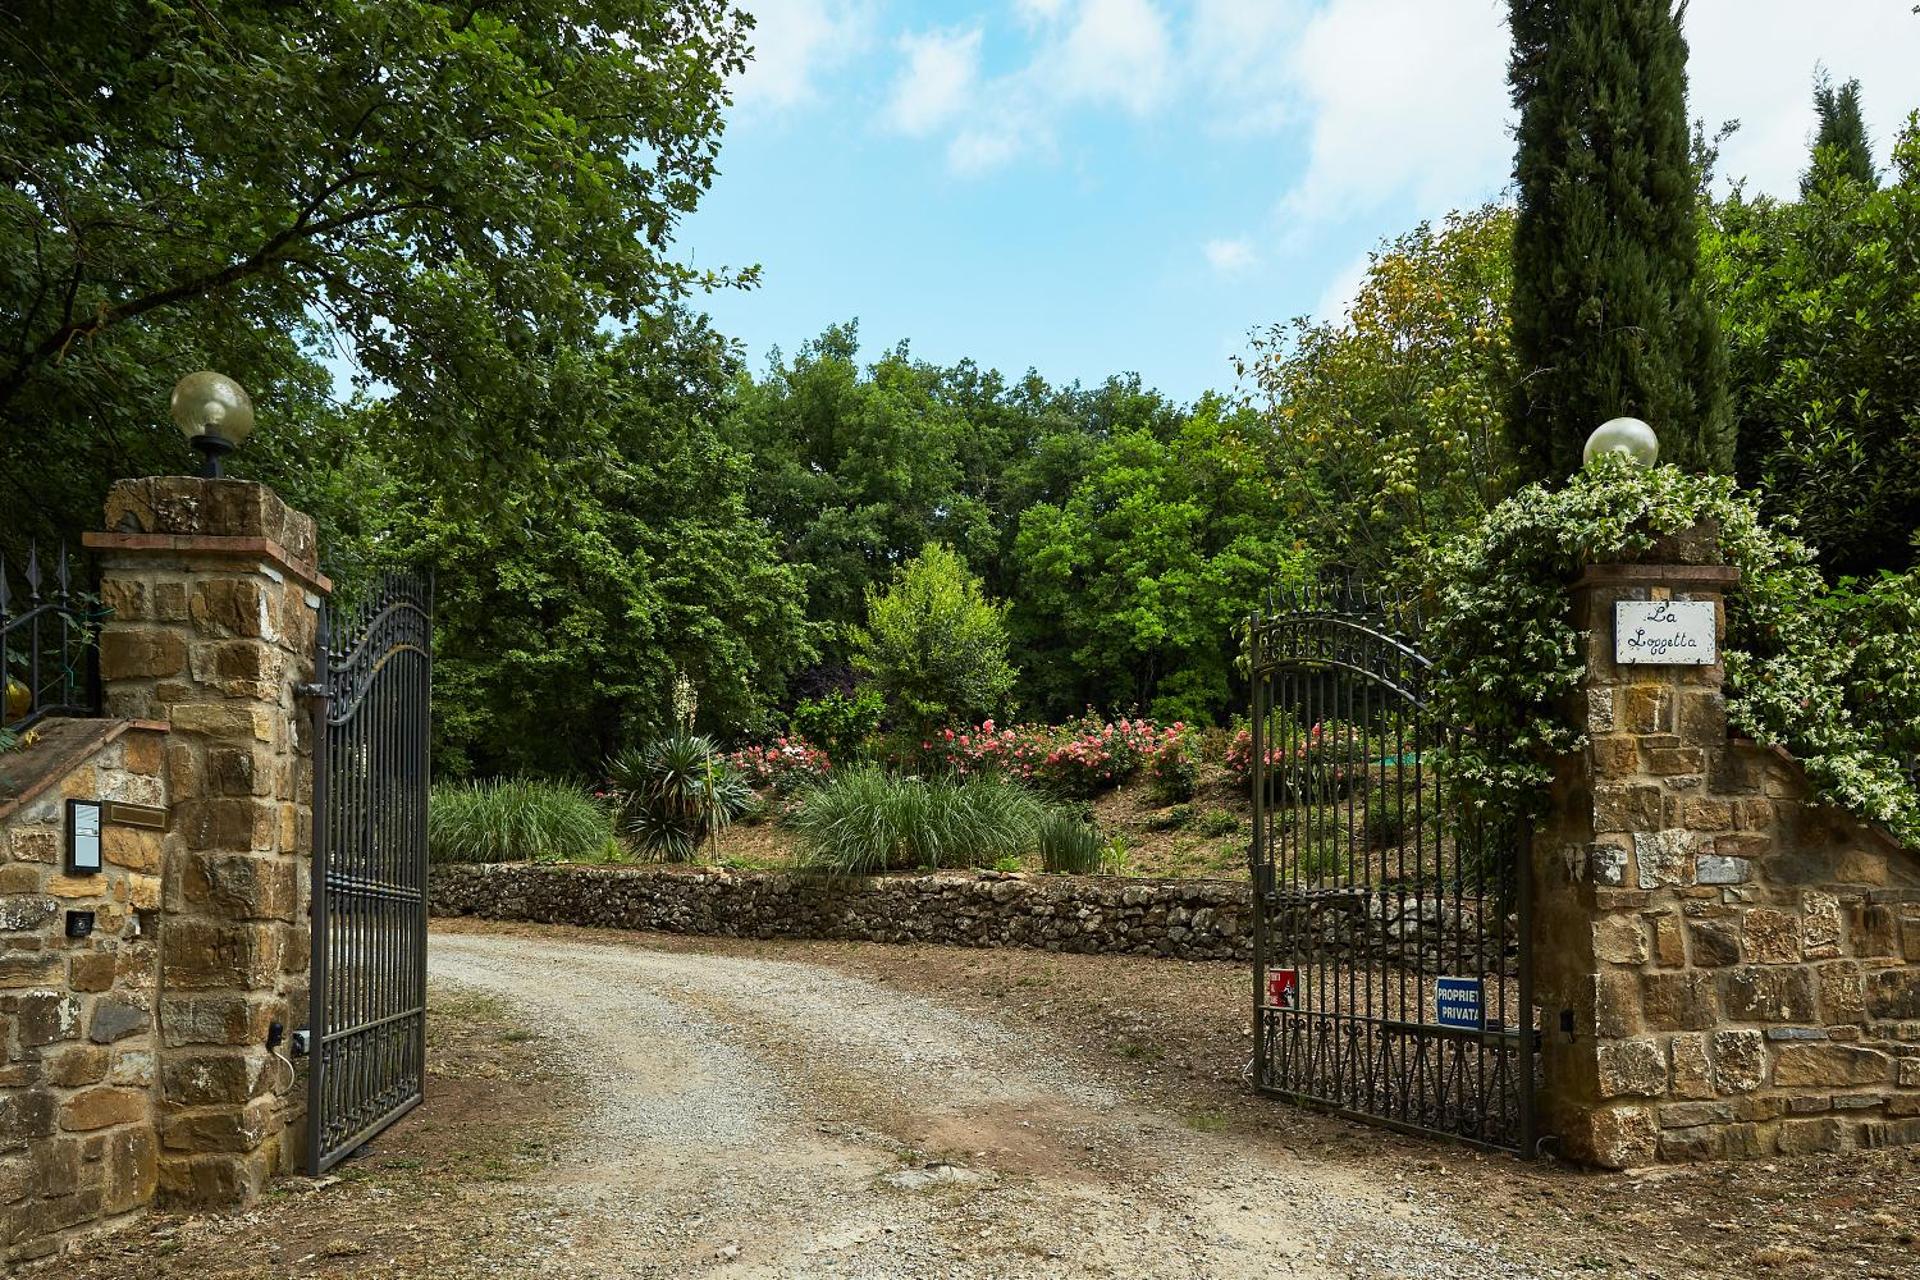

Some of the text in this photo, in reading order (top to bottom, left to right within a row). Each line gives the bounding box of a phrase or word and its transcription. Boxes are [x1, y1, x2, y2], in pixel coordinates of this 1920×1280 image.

[1647, 606, 1677, 622] La
[1628, 629, 1697, 655] Loggetta
[1438, 988, 1479, 1002] PROPRIET
